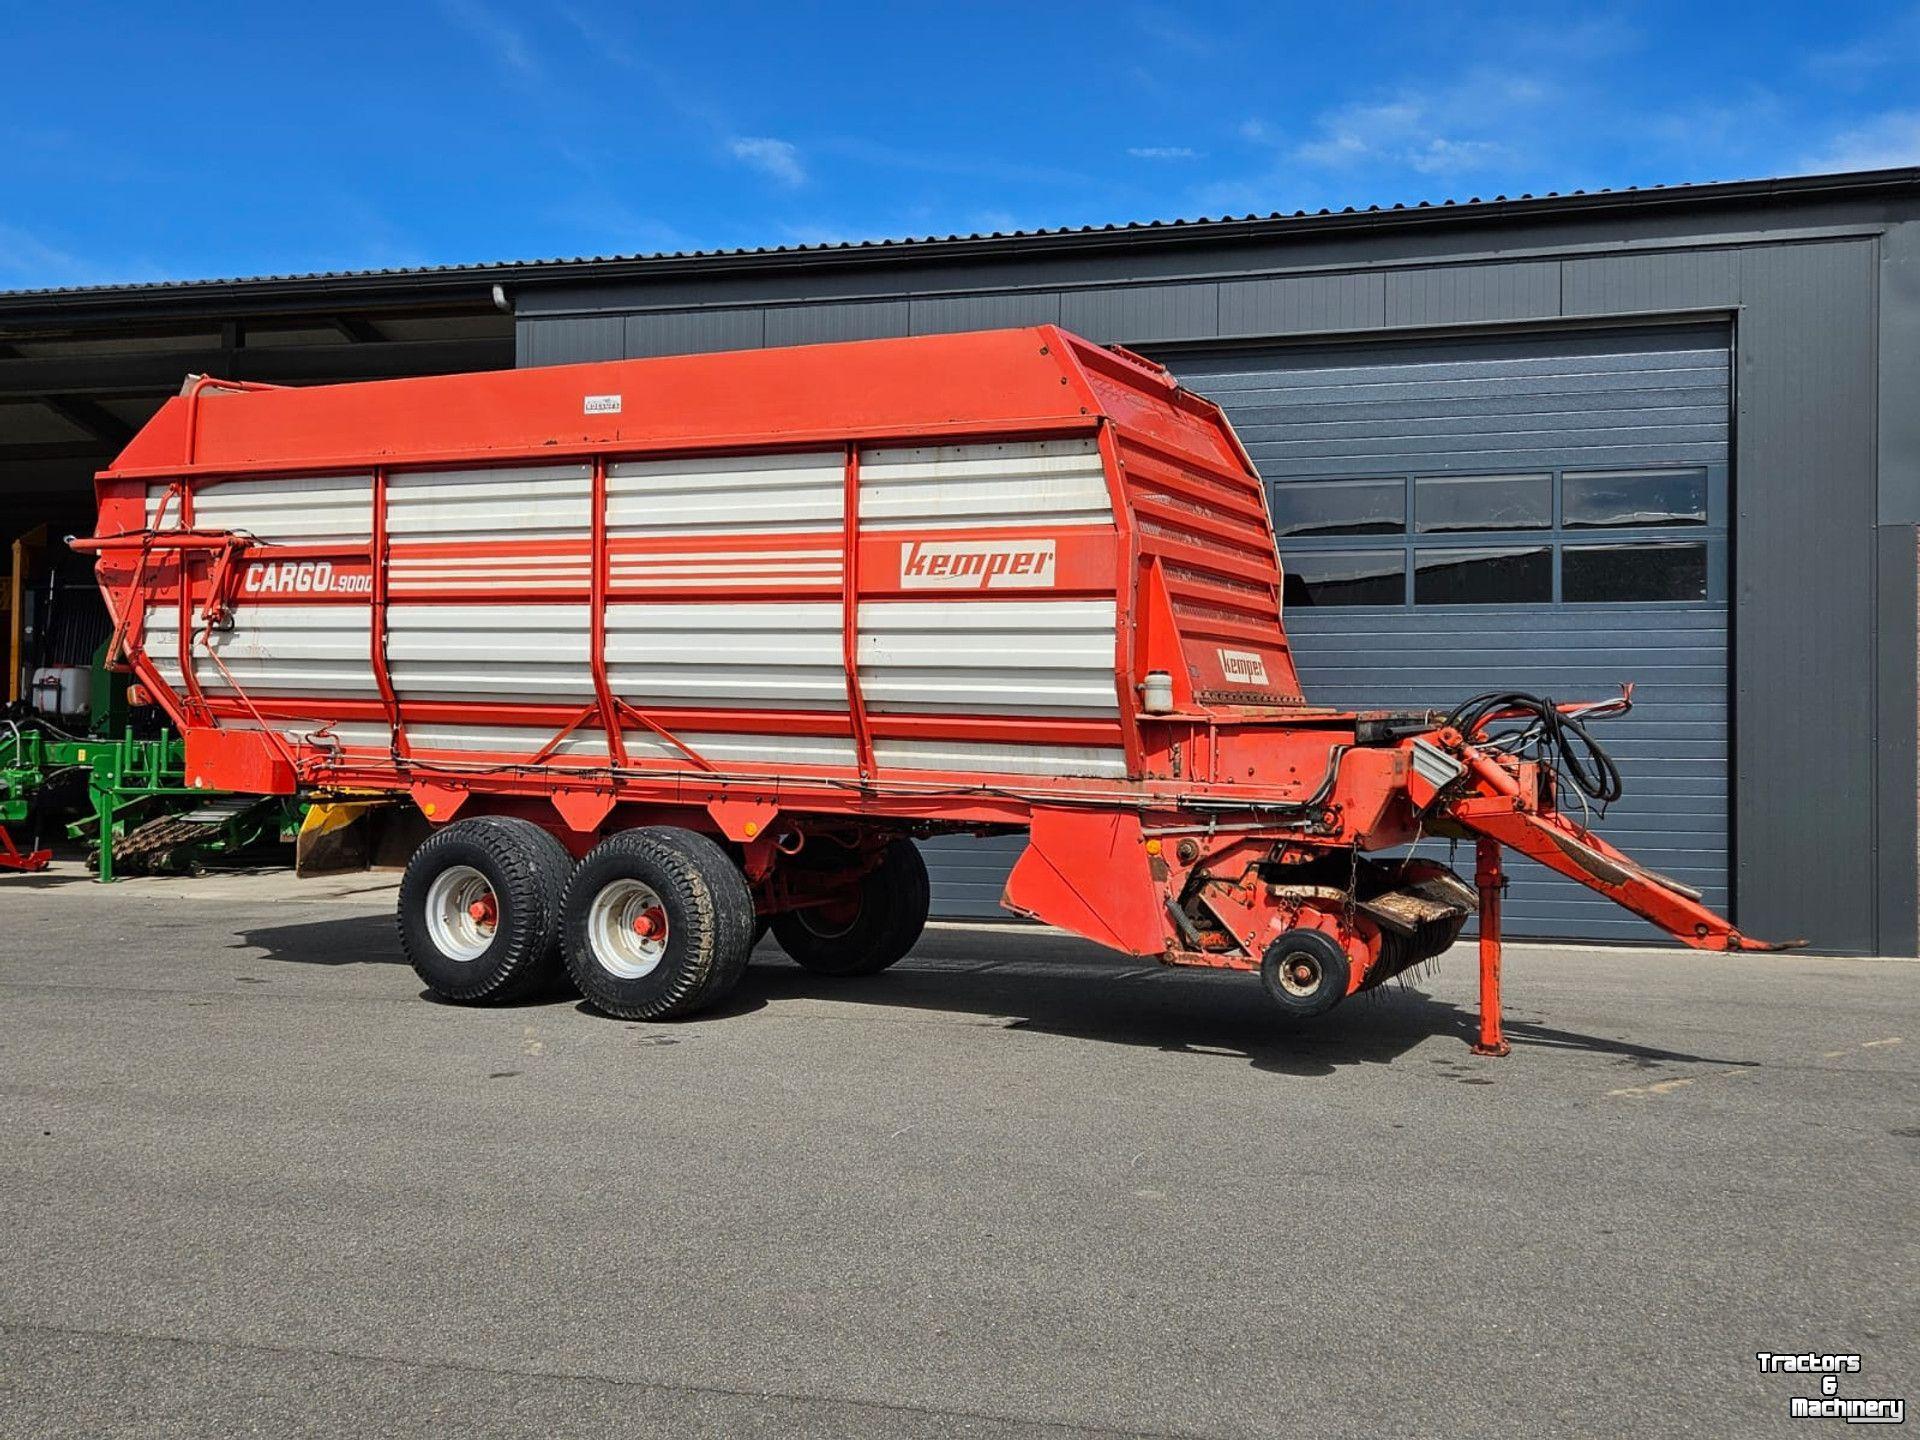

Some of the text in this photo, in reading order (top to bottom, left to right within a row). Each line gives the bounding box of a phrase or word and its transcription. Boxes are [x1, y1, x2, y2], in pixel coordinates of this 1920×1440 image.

[245, 562, 332, 592] CARGO
[904, 541, 1048, 588] kemper
[1221, 649, 1263, 683] kemper
